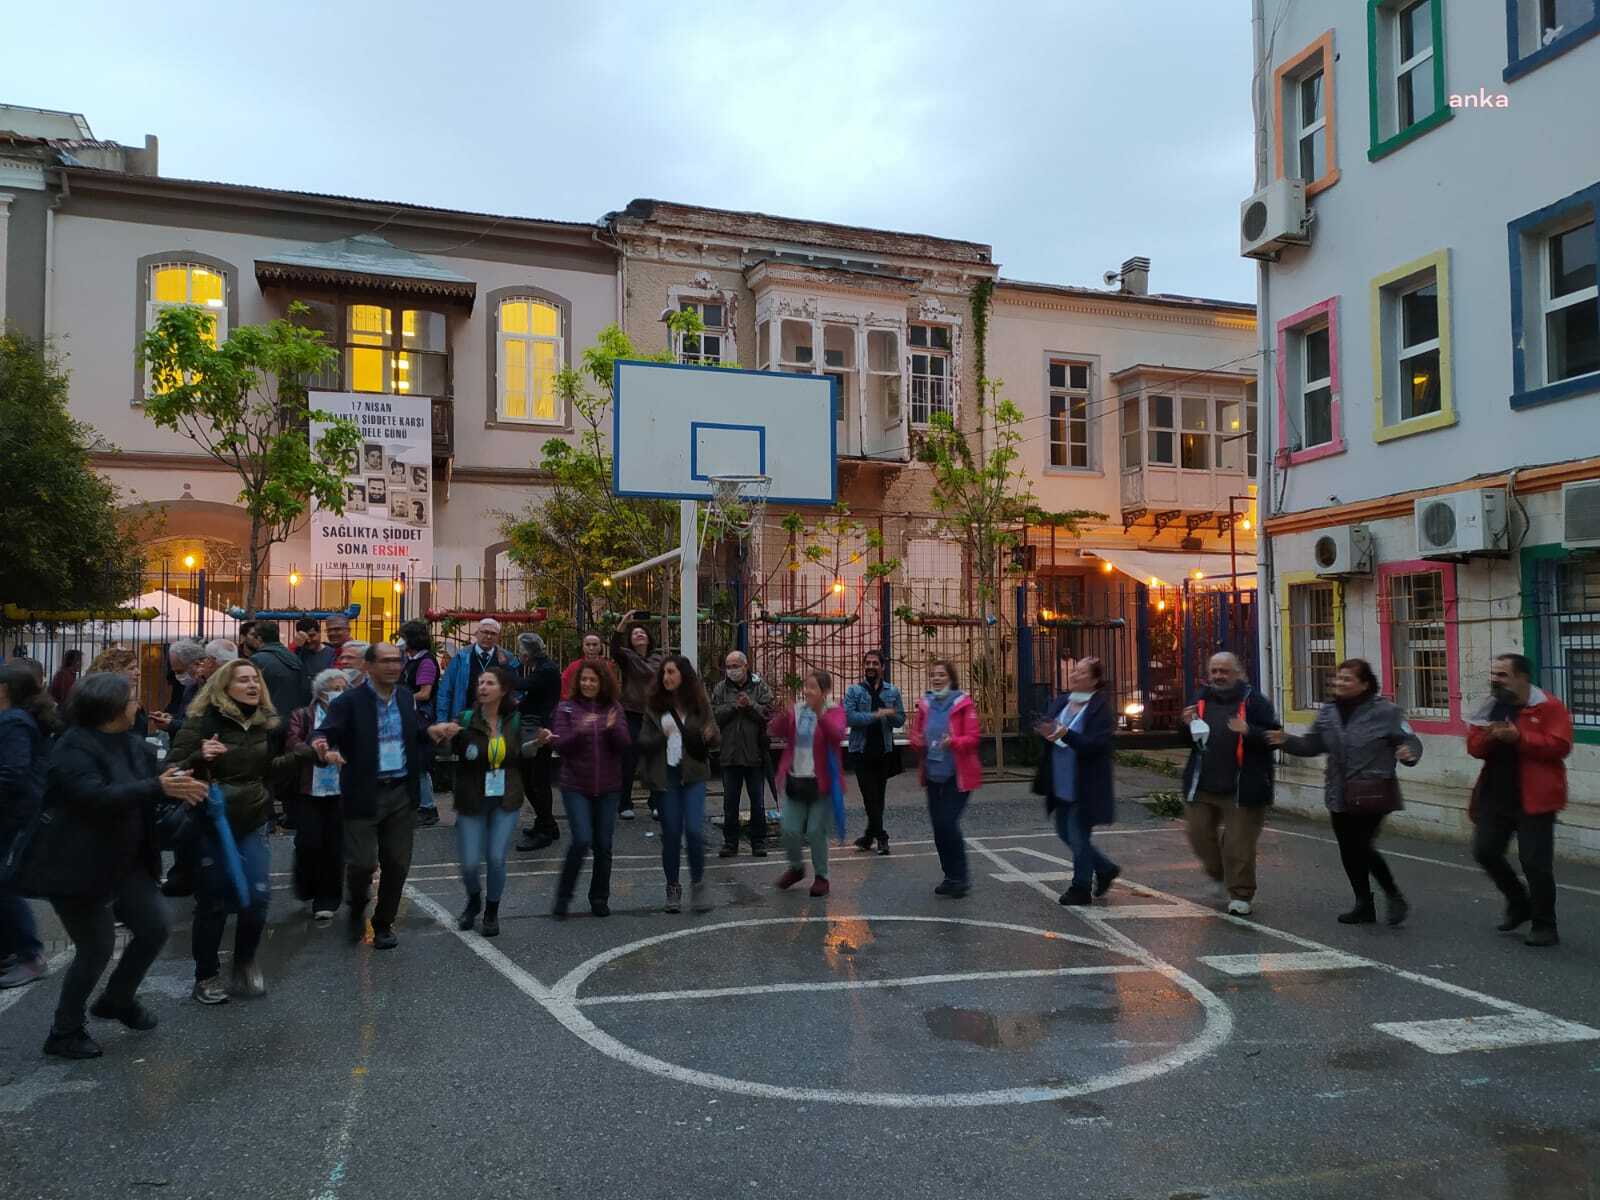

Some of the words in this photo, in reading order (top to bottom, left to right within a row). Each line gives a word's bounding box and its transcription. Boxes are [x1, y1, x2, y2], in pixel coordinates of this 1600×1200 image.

[352, 401, 362, 411] 17
[322, 525, 379, 539] SAĞLIKTA
[383, 526, 422, 542] ŞİDDET
[337, 543, 368, 555] SONA
[372, 543, 409, 556] ERSİN!
